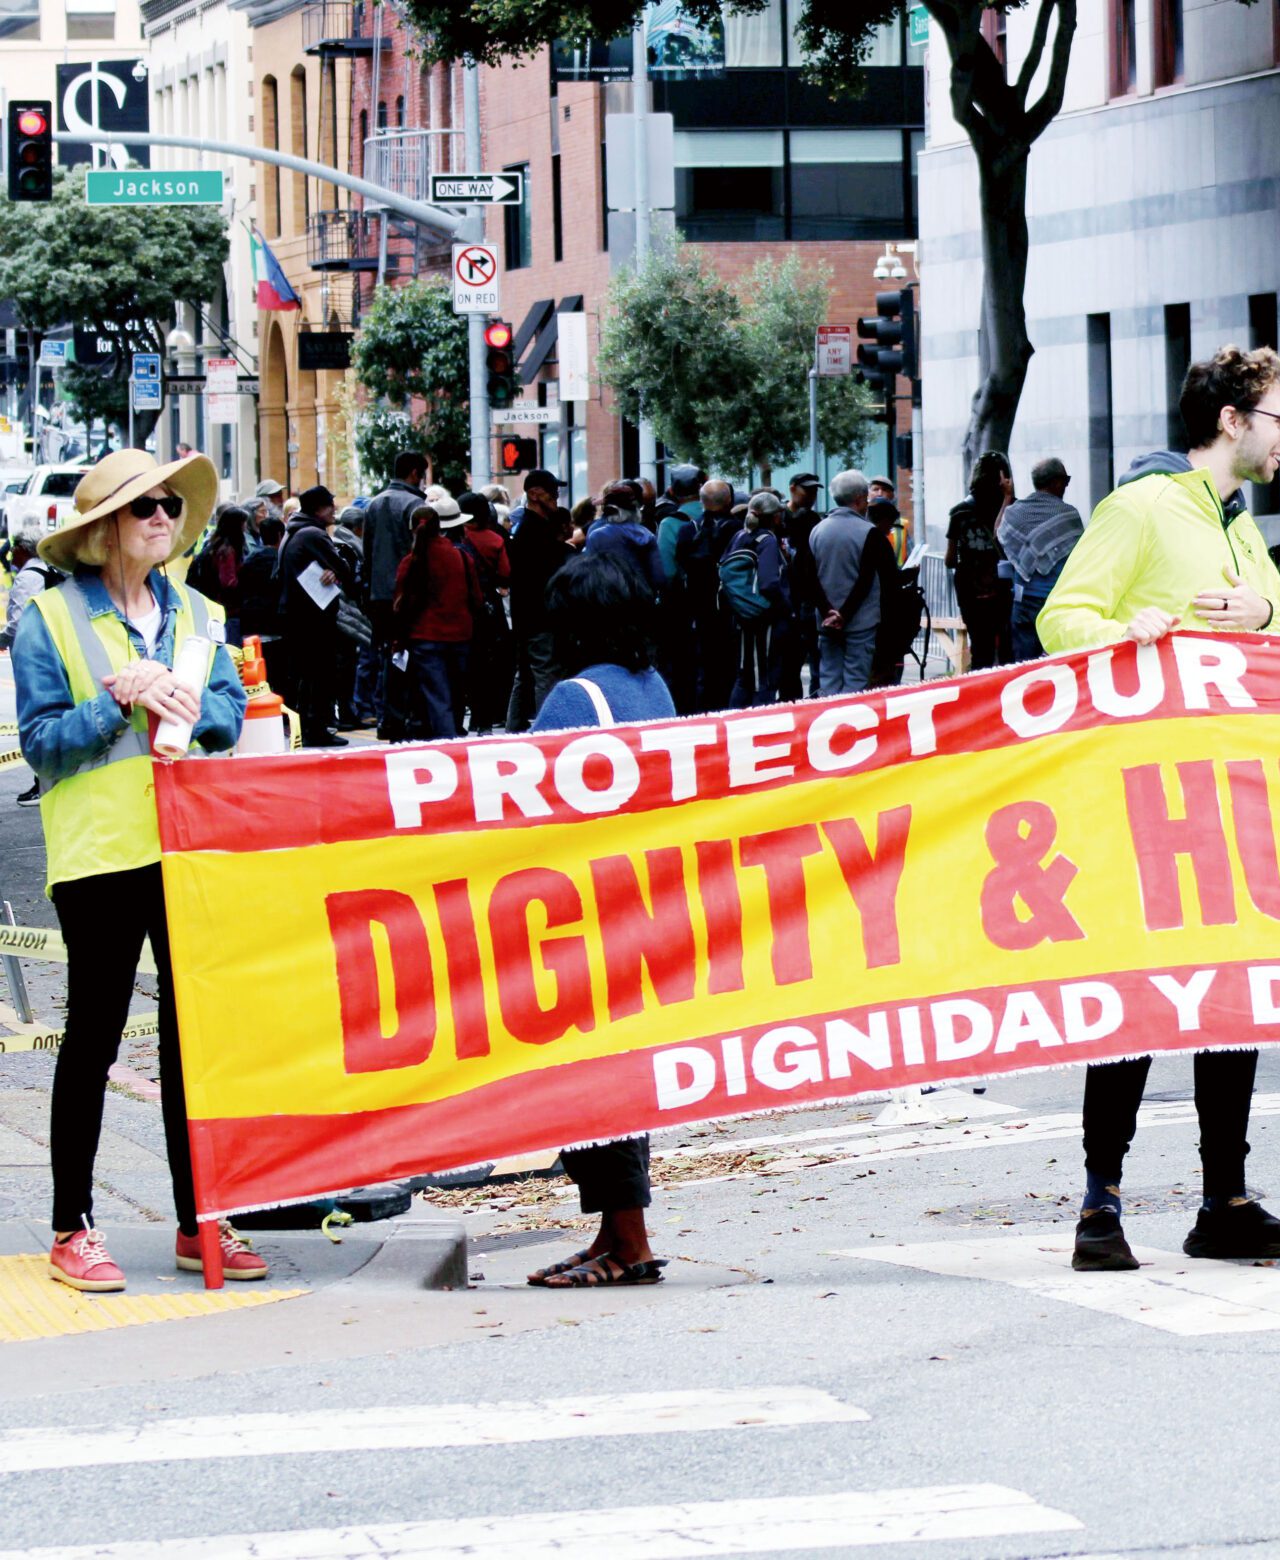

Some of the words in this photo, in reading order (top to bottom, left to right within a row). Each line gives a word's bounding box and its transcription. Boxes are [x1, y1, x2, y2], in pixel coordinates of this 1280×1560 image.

[113, 178, 200, 196] Jackson
[438, 183, 464, 196] ONE
[467, 183, 494, 195] WAY
[457, 294, 471, 304] ON
[476, 294, 496, 304] RED
[503, 411, 549, 421] Jackson
[386, 686, 961, 829] PROTECT
[1000, 633, 1257, 739] OUR
[325, 804, 912, 1074] DIGNITY
[979, 801, 1086, 951] &
[653, 982, 1124, 1111] DIGNIDAD
[1148, 969, 1217, 1032] Y
